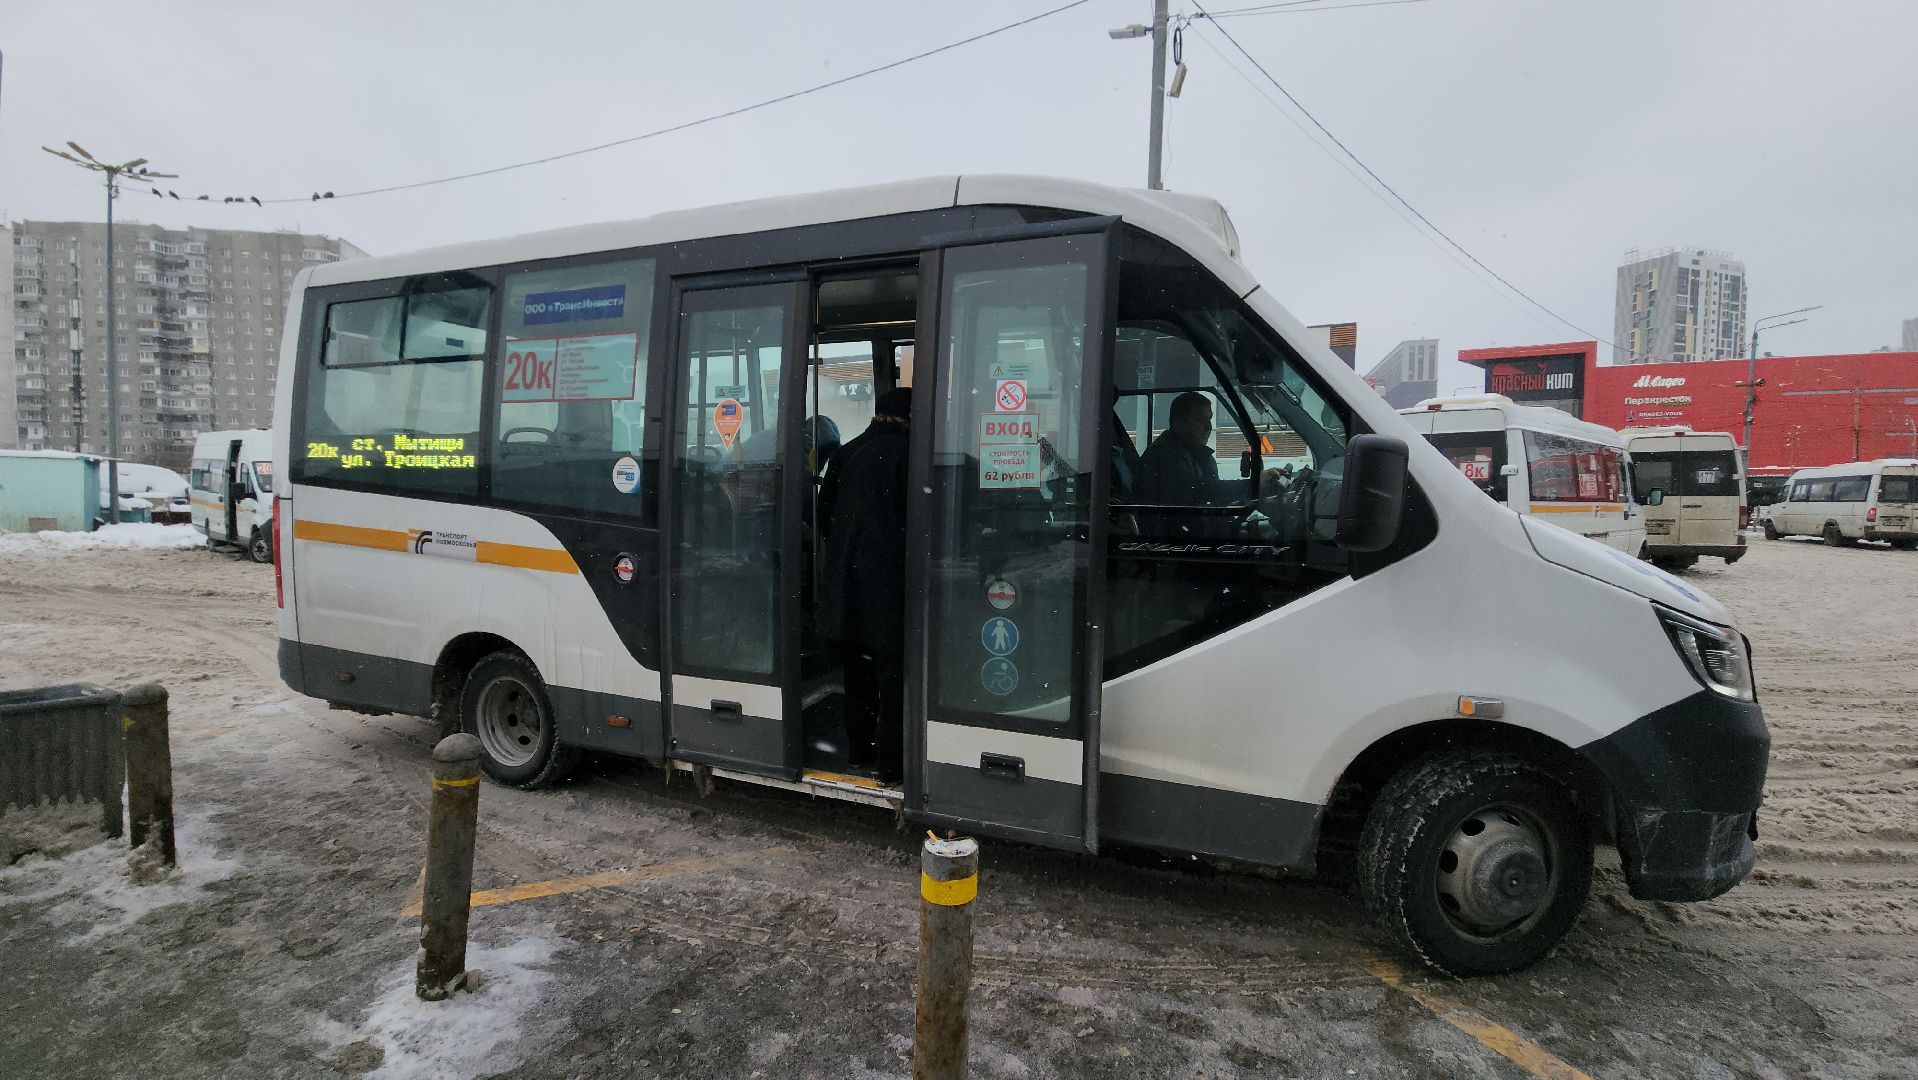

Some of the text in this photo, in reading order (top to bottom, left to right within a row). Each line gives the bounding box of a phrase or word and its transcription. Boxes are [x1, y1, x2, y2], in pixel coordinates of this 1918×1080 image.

[525, 303, 546, 315] ООО
[985, 422, 1033, 438] ВХОД
[351, 434, 465, 452] ст. Мытищи
[341, 450, 475, 468] ул. Троицкая
[985, 471, 999, 481] 62
